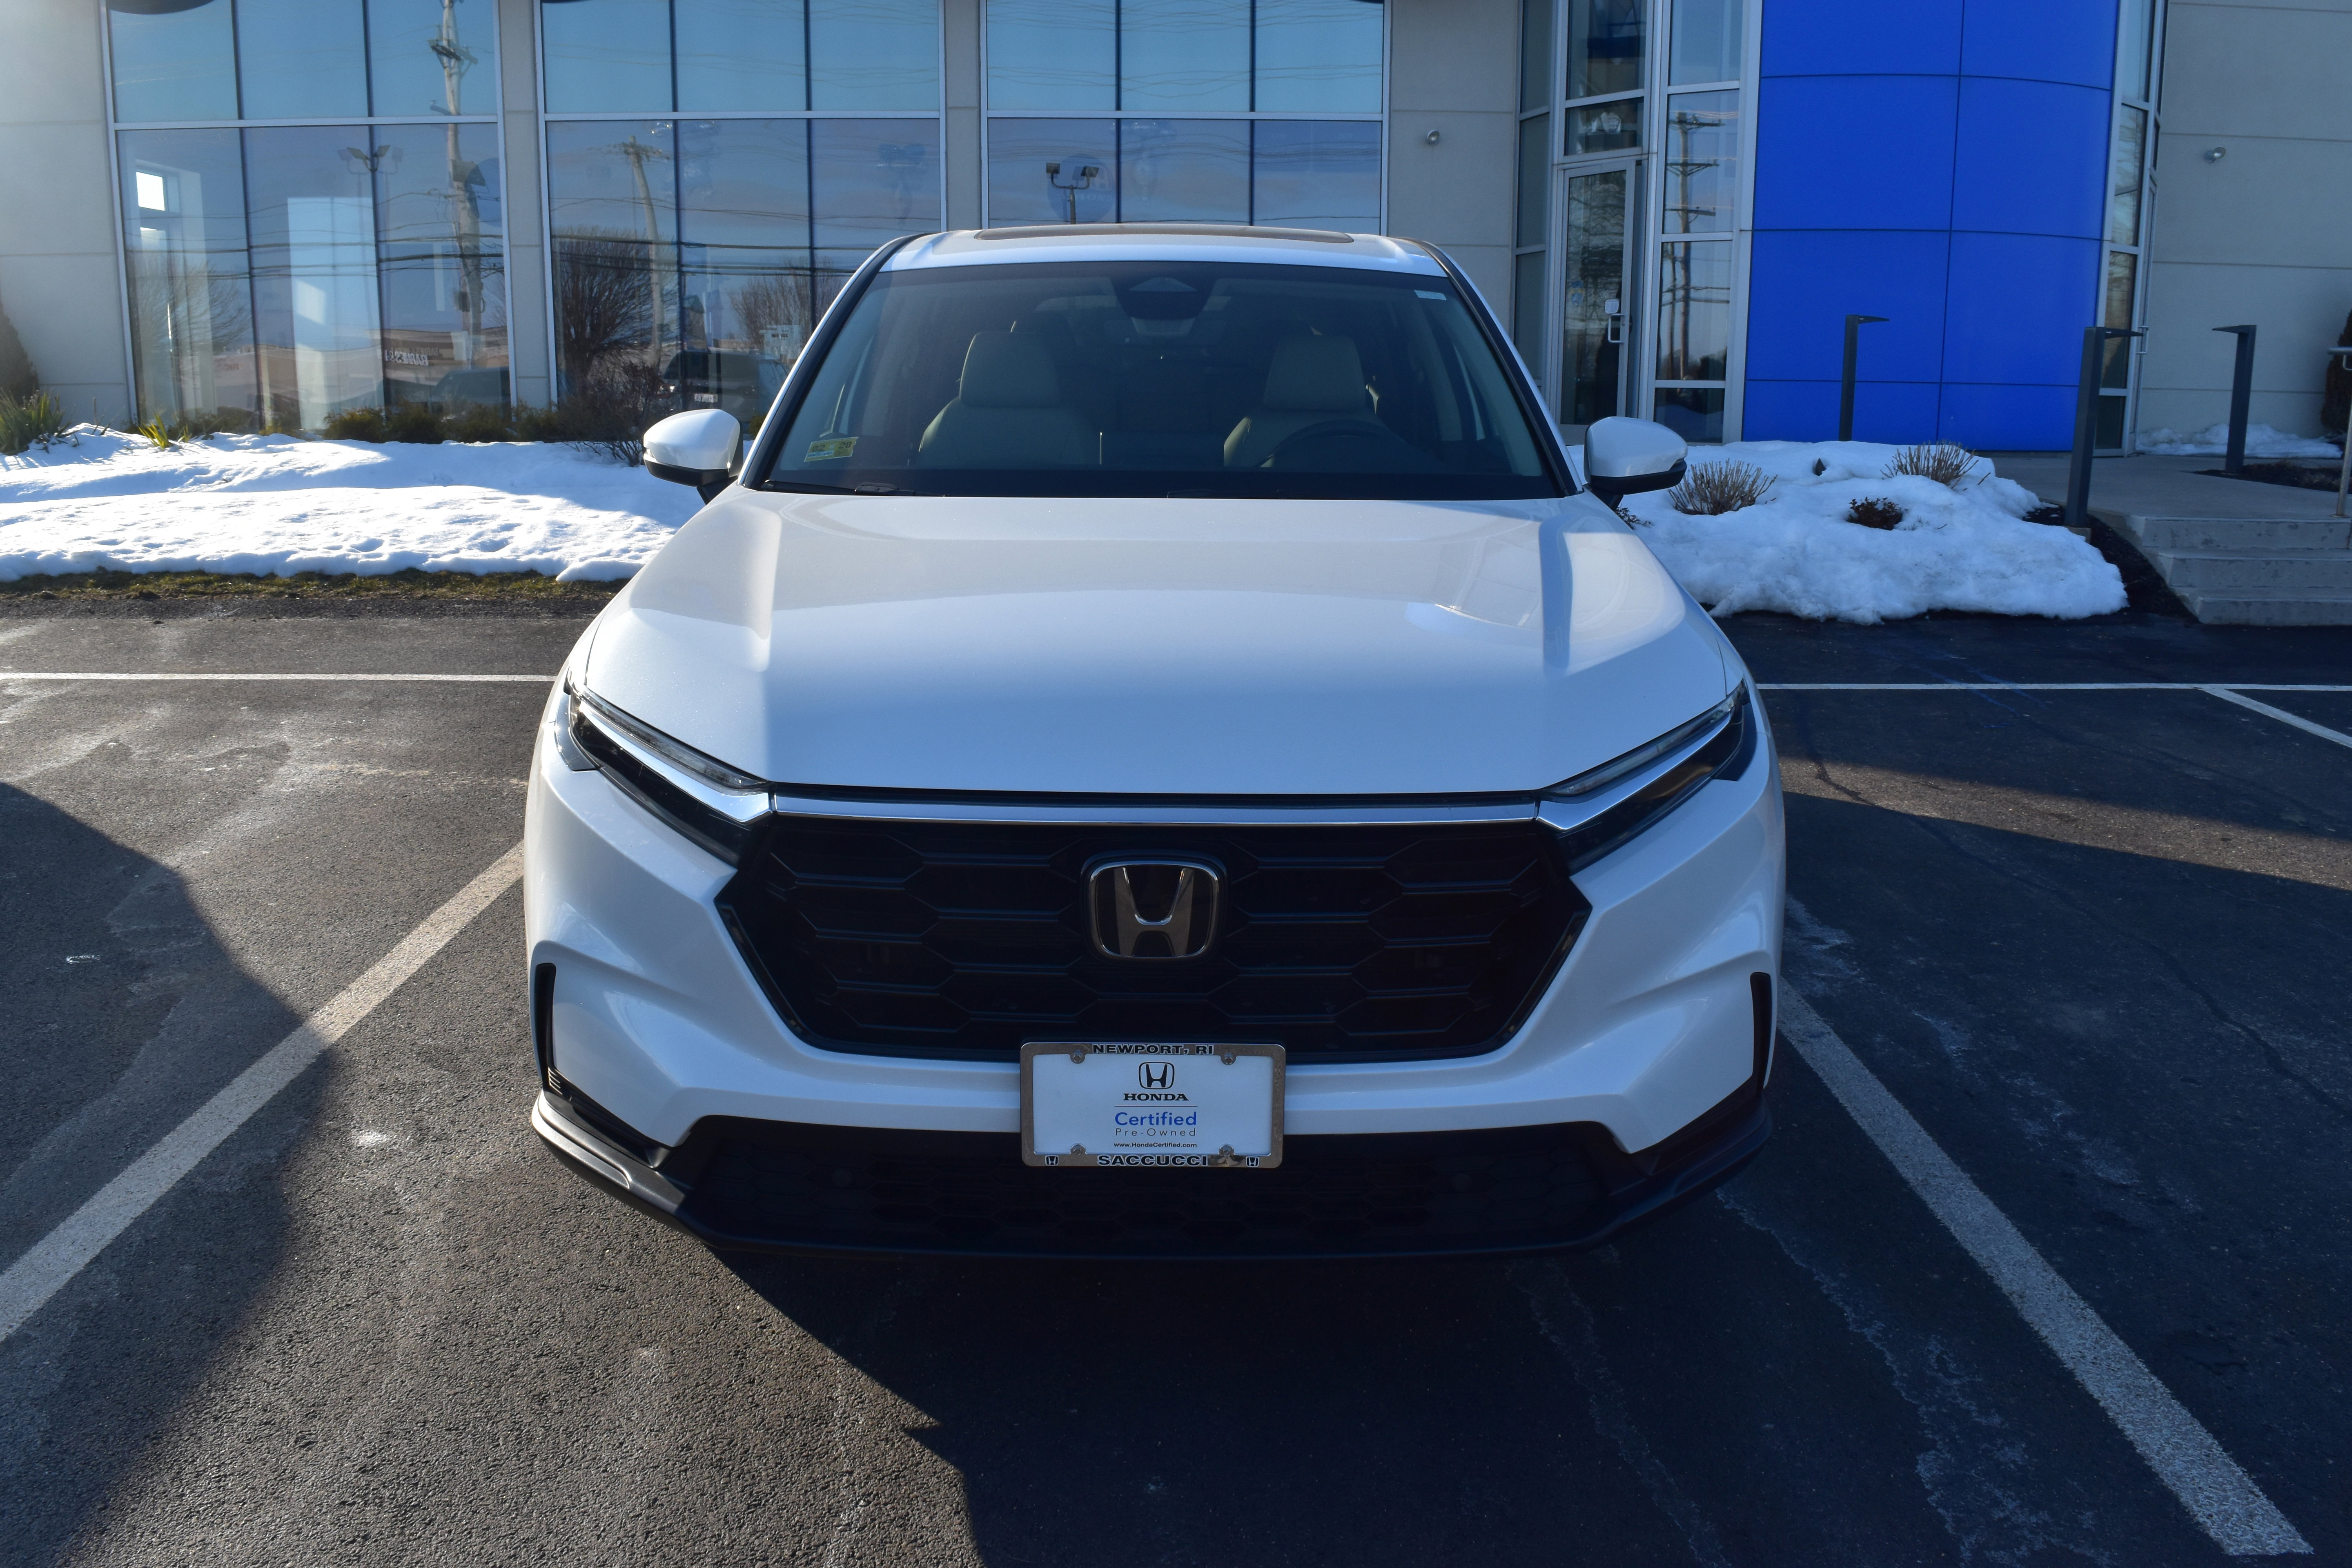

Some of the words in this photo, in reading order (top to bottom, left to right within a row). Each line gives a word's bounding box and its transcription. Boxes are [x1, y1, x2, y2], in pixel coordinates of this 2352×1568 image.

[1093, 1044, 1189, 1054] NEWPORT,
[1196, 1045, 1214, 1054] RI
[1115, 1111, 1196, 1125] Certified
[1116, 1128, 1196, 1136] Pre-Owned
[1098, 1155, 1207, 1166] SACCUCCI
